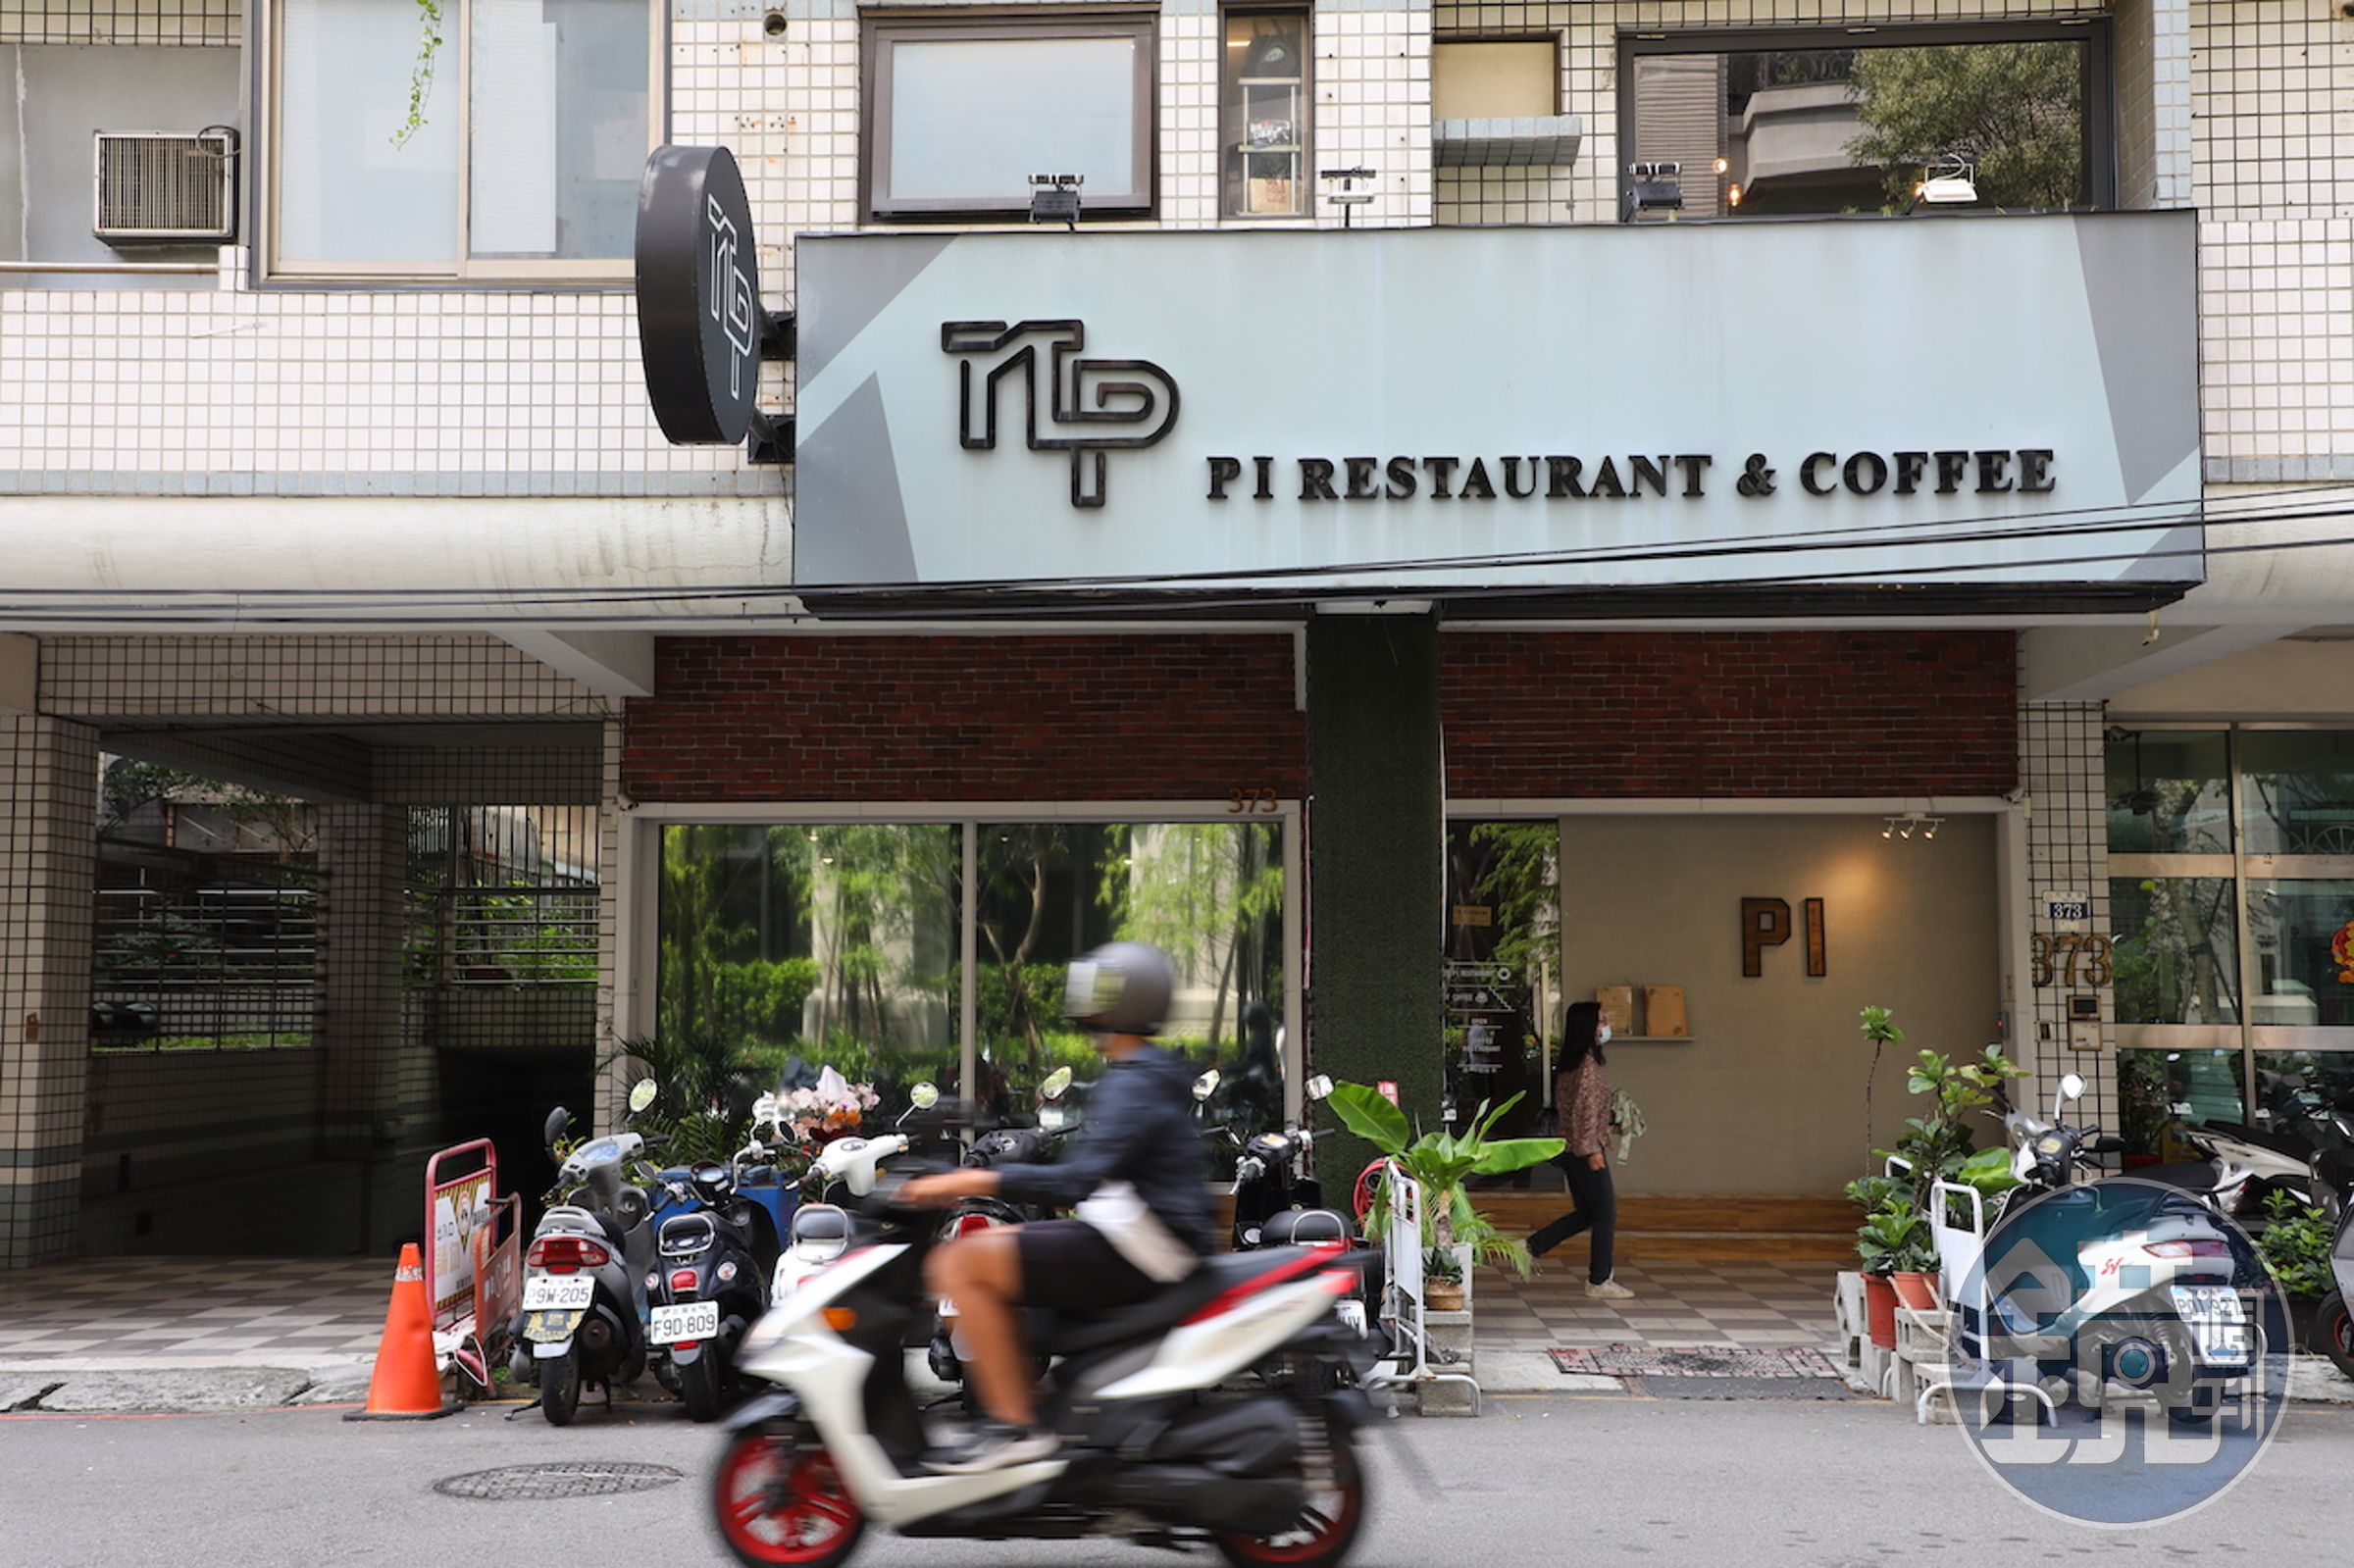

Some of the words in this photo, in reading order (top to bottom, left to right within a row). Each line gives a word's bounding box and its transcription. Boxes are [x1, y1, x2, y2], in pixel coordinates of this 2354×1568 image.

[1206, 456, 1274, 499] PI
[1298, 454, 1713, 500] RESTAURANT
[1736, 452, 1777, 497] &
[1800, 449, 2057, 496] COFFEE
[1227, 787, 1279, 813] 373
[2053, 903, 2083, 919] 373
[1741, 896, 1826, 978] PI
[2031, 935, 2113, 987] 373
